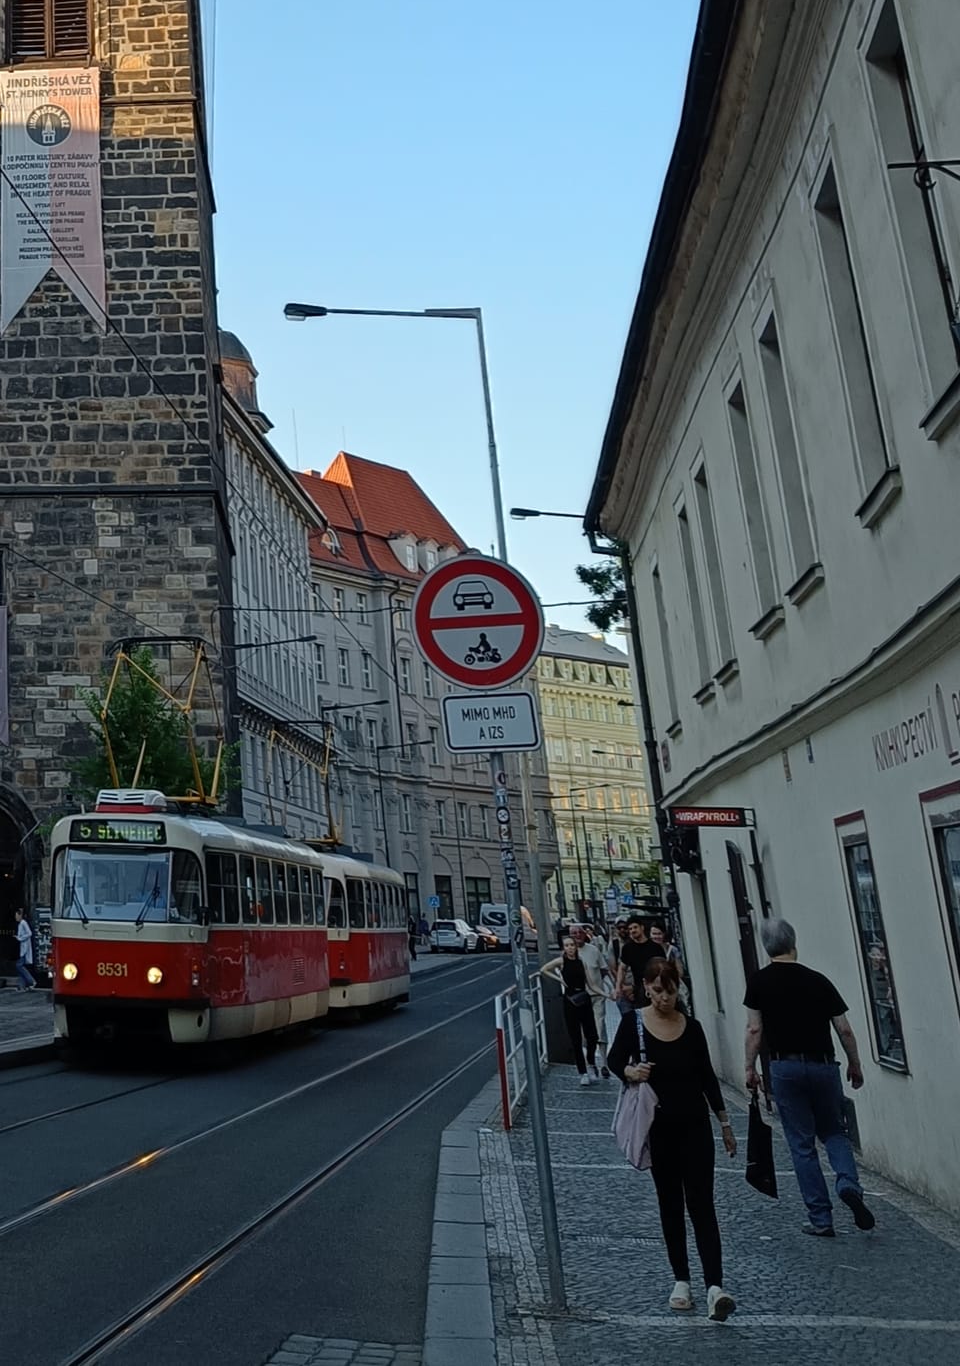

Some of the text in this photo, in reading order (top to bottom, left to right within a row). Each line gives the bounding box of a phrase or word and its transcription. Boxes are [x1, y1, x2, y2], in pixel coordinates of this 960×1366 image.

[6, 74, 92, 88] JINDŘIŠSKÁ VĚŽ
[60, 87, 92, 96] TOWER
[461, 705, 516, 722] MIMO MHD
[479, 725, 505, 740] A IZS
[79, 823, 92, 839] 5
[97, 962, 128, 977] 8531
